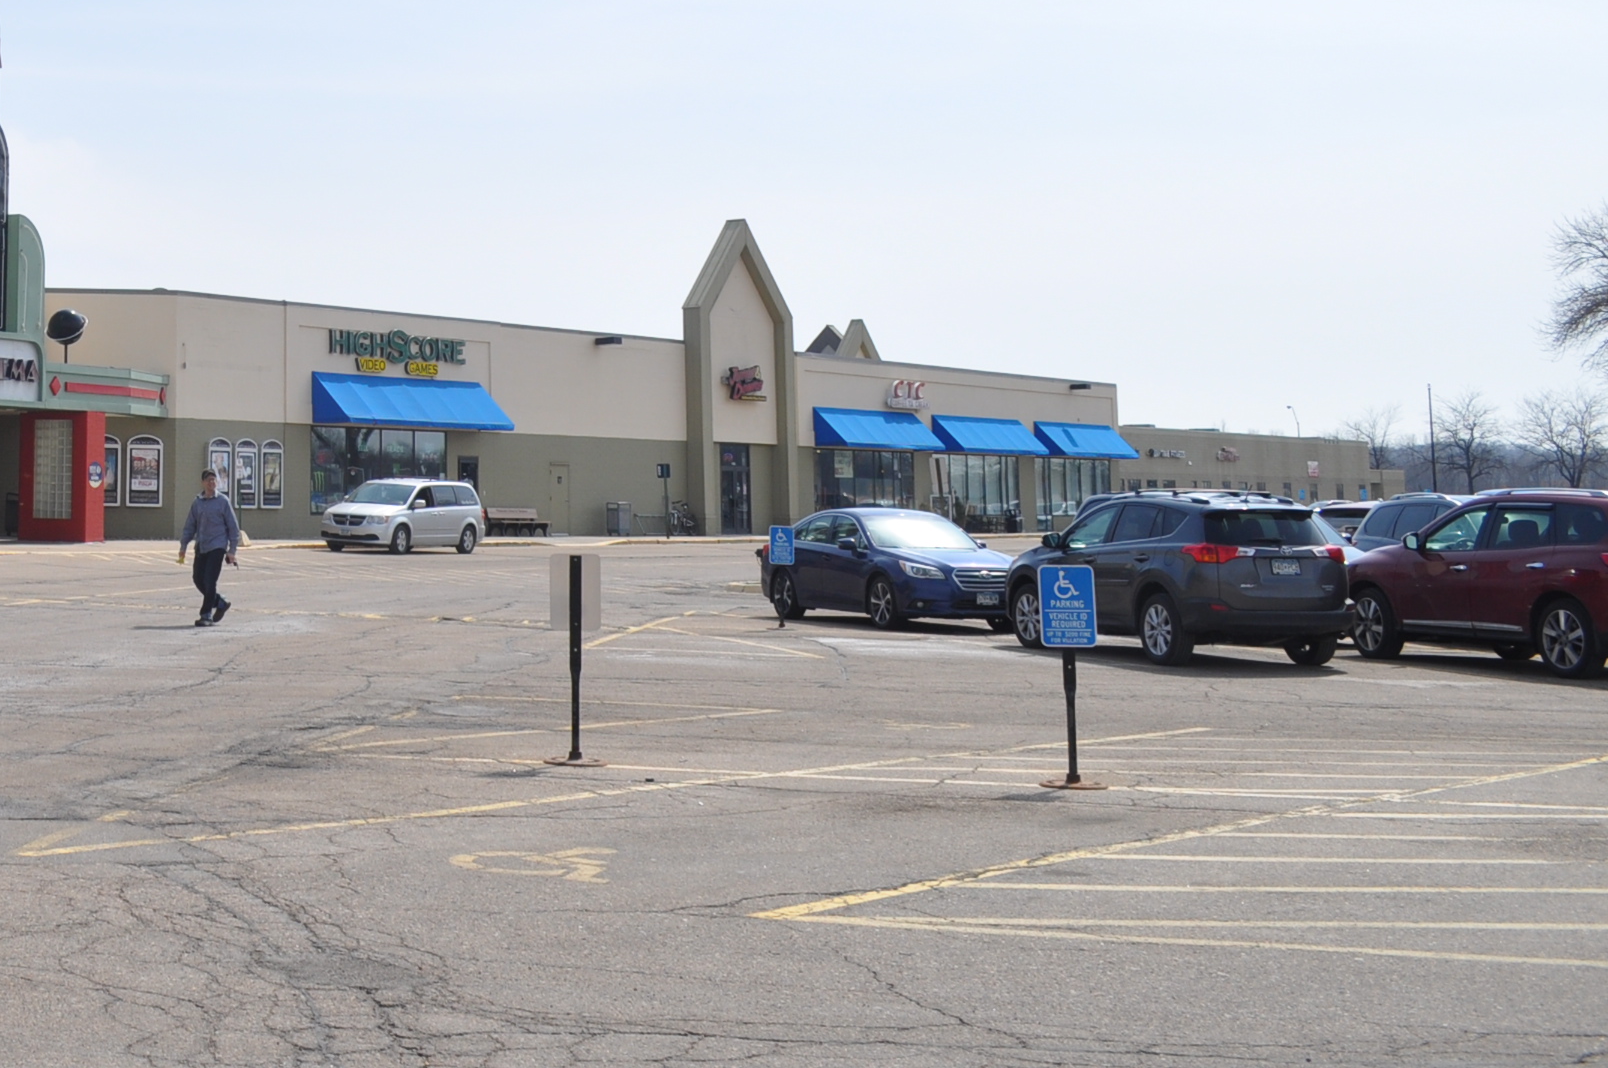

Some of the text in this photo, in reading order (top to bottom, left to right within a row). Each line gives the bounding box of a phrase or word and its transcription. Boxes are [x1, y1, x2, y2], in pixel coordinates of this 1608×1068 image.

[356, 357, 439, 376] VIDEO GAMES
[893, 379, 925, 400] CTC
[1050, 600, 1084, 608] PARKING
